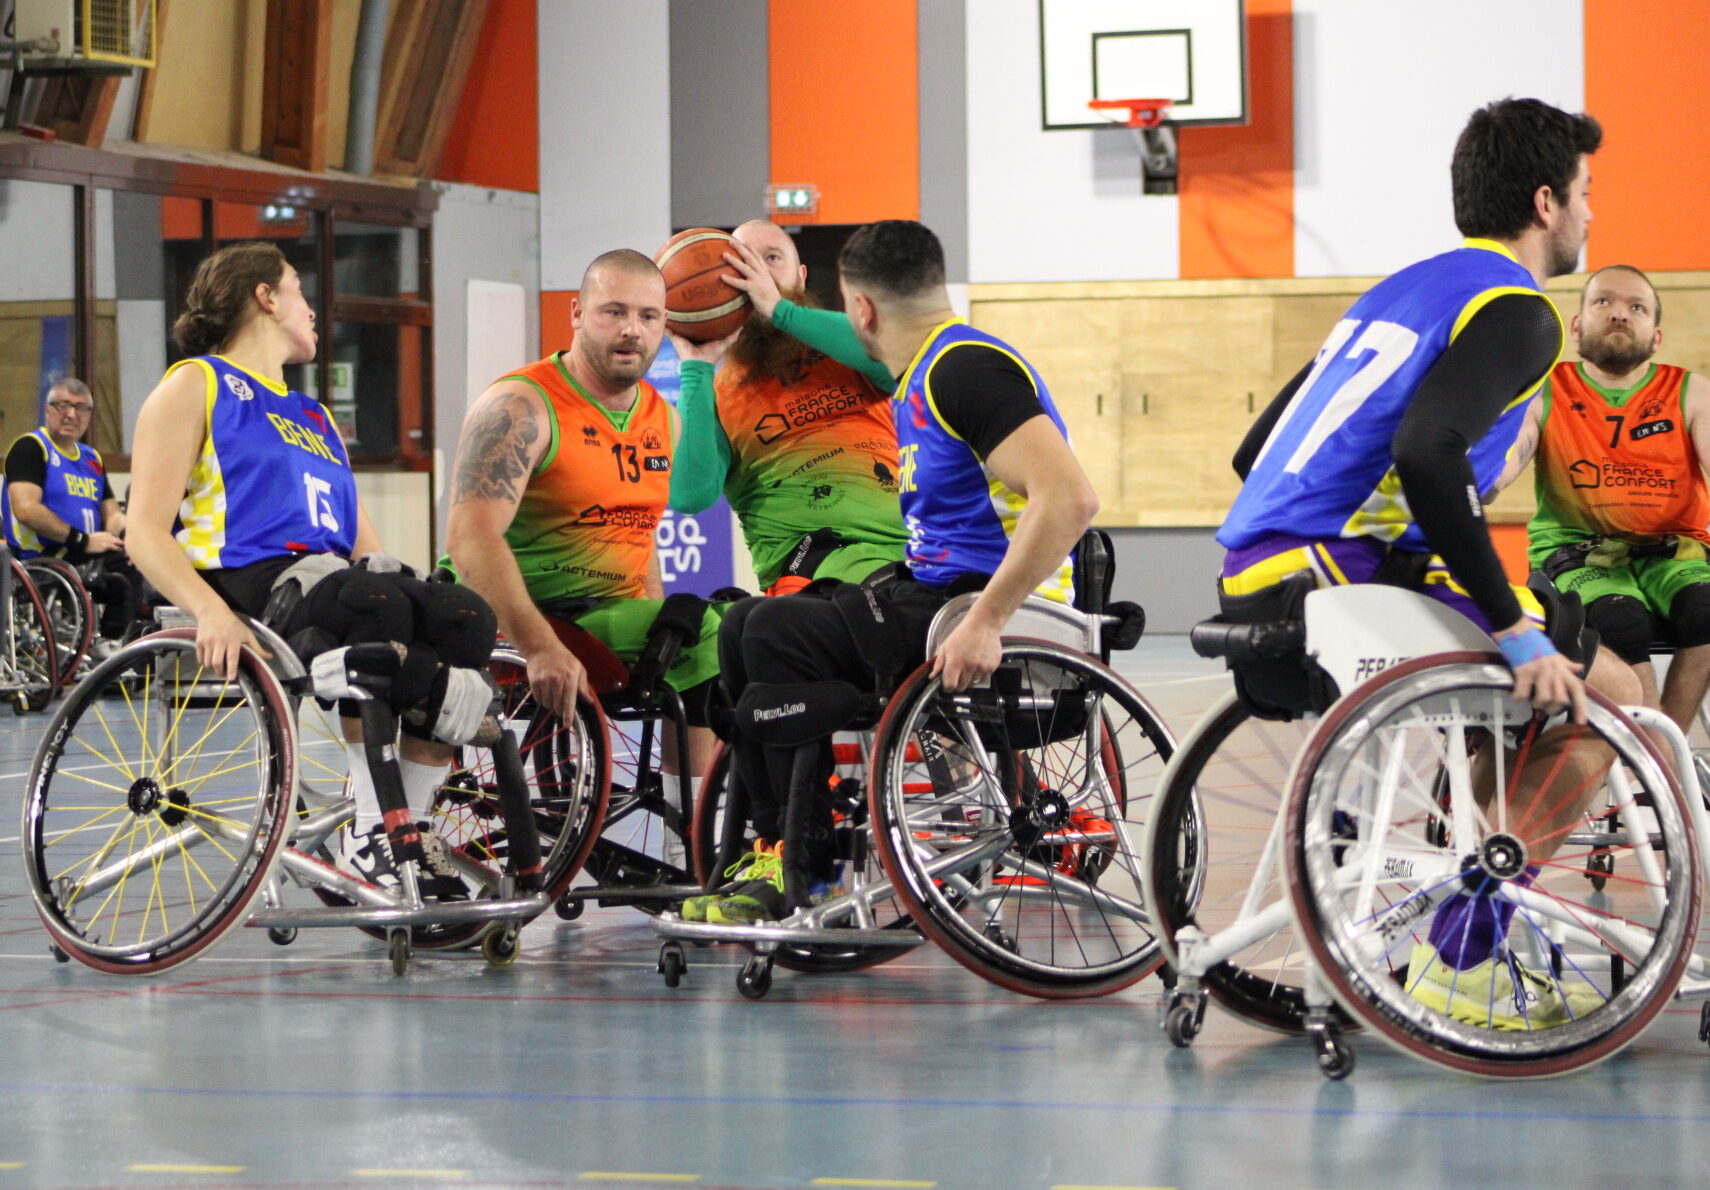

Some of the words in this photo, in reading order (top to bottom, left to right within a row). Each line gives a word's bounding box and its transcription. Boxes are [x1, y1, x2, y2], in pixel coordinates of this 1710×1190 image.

[788, 386, 852, 417] FRANCE
[793, 394, 866, 427] CONFORT
[1250, 318, 1420, 475] 77
[265, 411, 343, 466] BENE
[1605, 415, 1625, 449] 7
[611, 443, 641, 483] 13
[1603, 464, 1665, 477] FRANCE
[64, 472, 98, 501] BENE
[1603, 476, 1677, 490] CONFORT
[303, 472, 340, 533] 15
[560, 565, 627, 582] ACTEMIUM
